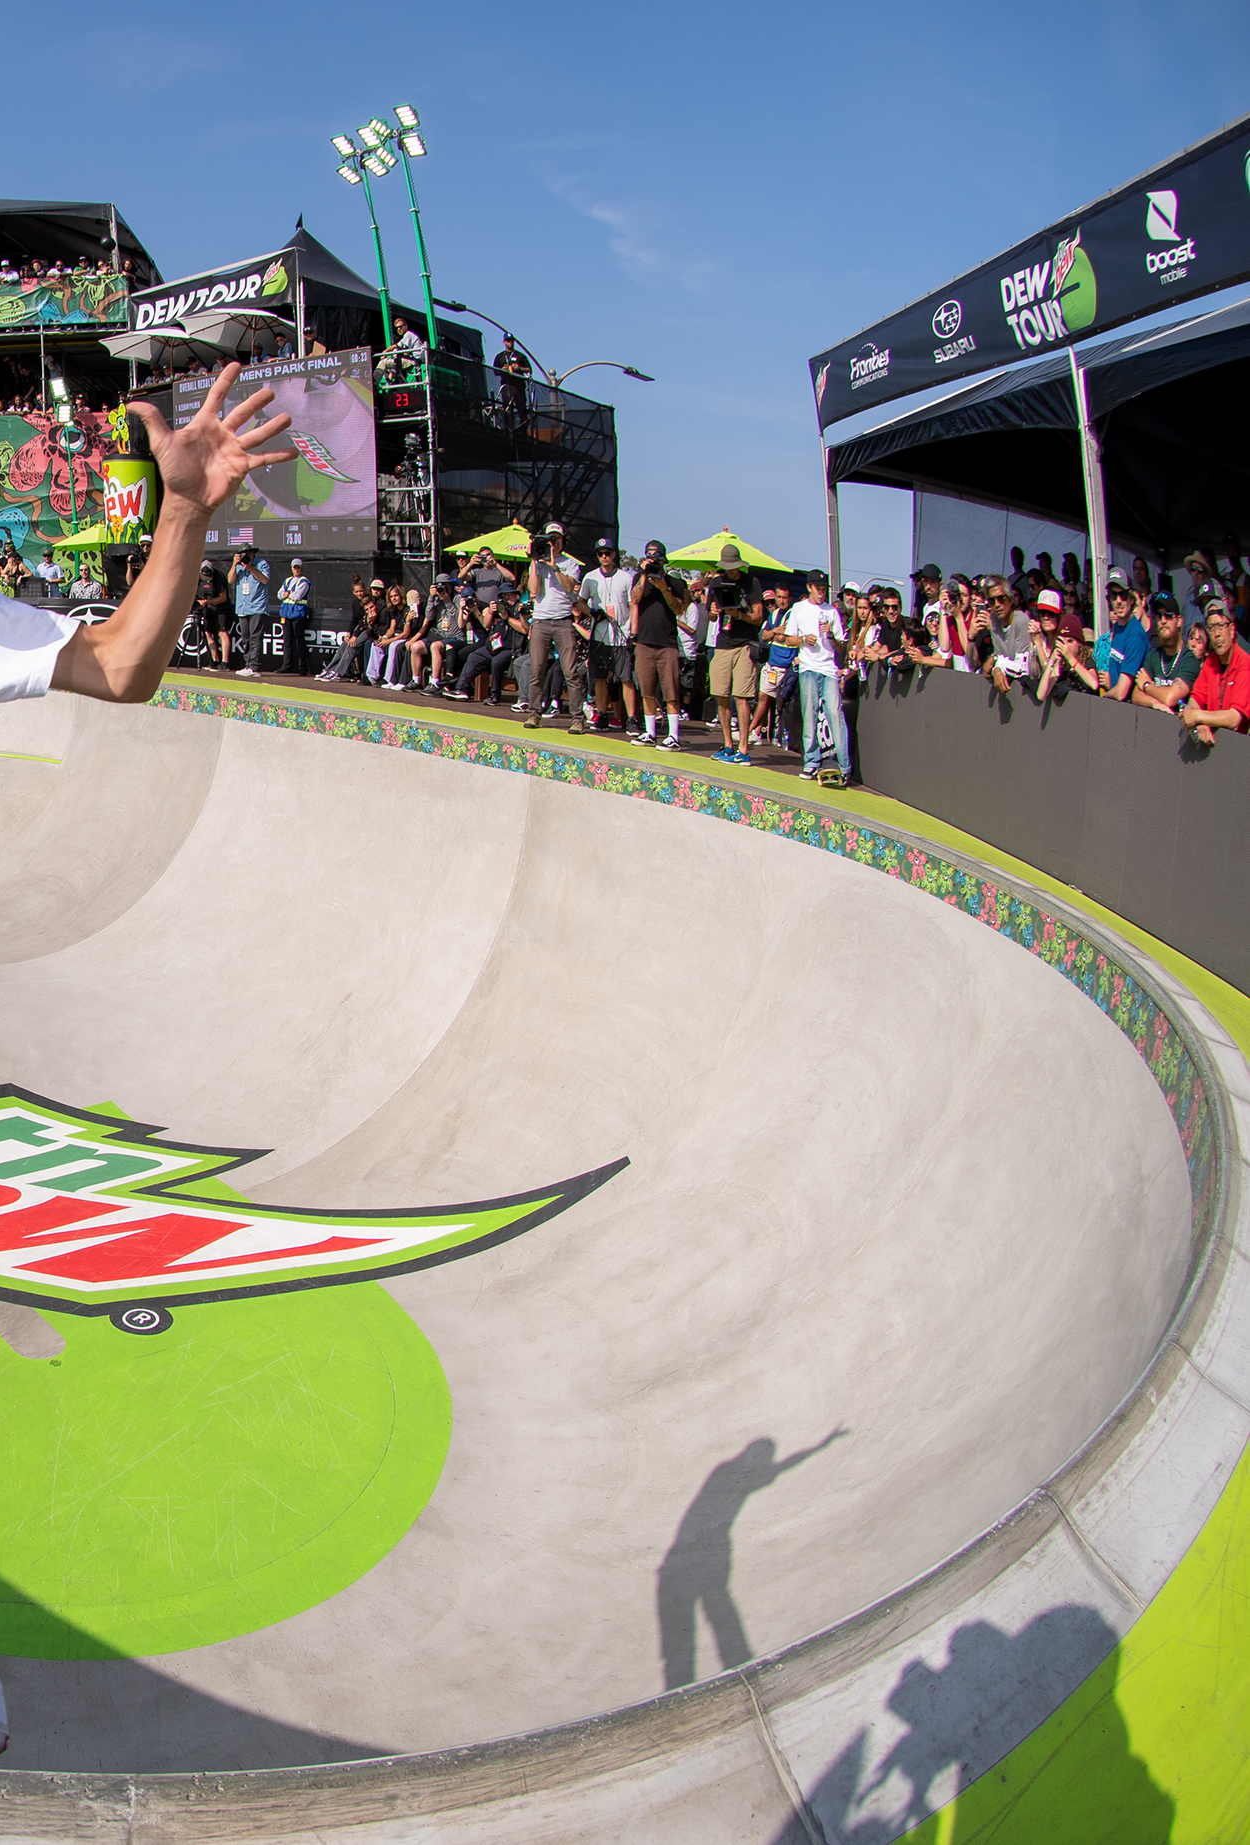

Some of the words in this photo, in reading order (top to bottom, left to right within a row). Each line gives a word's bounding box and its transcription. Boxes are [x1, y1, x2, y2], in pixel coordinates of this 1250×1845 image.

[1146, 238, 1197, 274] boost
[1000, 260, 1051, 312] DEW
[1160, 267, 1188, 285] mobile
[1006, 299, 1070, 350] TOUR
[933, 334, 978, 364] SUBARU
[239, 368, 272, 382] MEN'S
[274, 361, 306, 376] PARK
[308, 356, 342, 371] FINAL
[851, 349, 890, 380] Frontier
[851, 368, 889, 390] COMMUNICATIONS
[396, 394, 408, 407] 23
